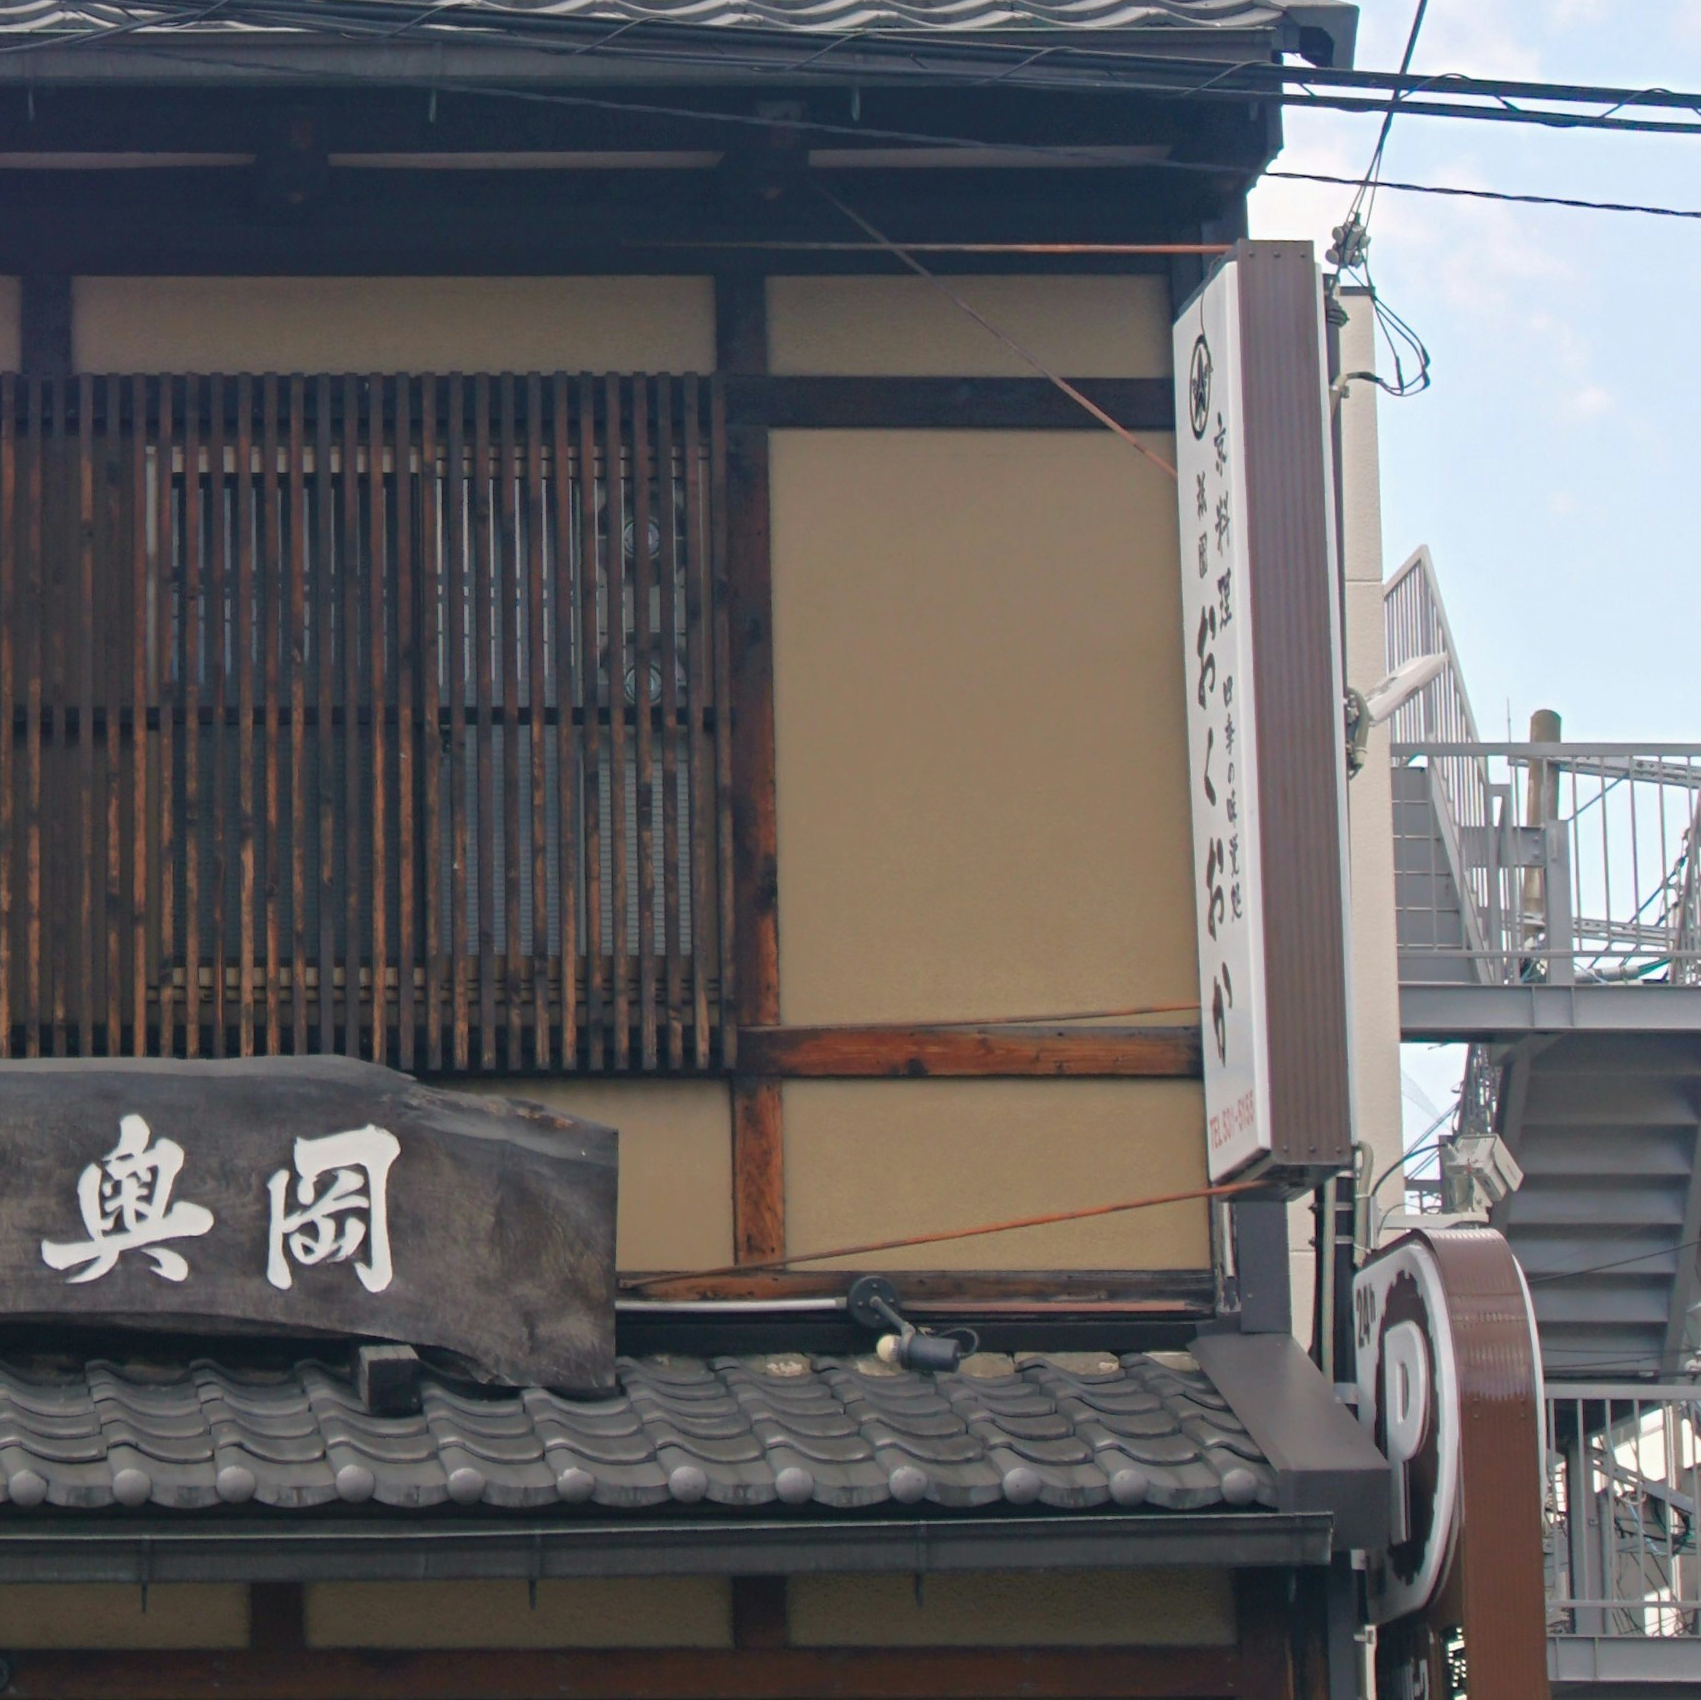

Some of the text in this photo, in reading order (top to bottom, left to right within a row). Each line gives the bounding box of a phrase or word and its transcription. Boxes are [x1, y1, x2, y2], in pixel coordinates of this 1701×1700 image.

[1197, 604, 1233, 1068] おくおか
[1385, 1320, 1431, 1545] P
